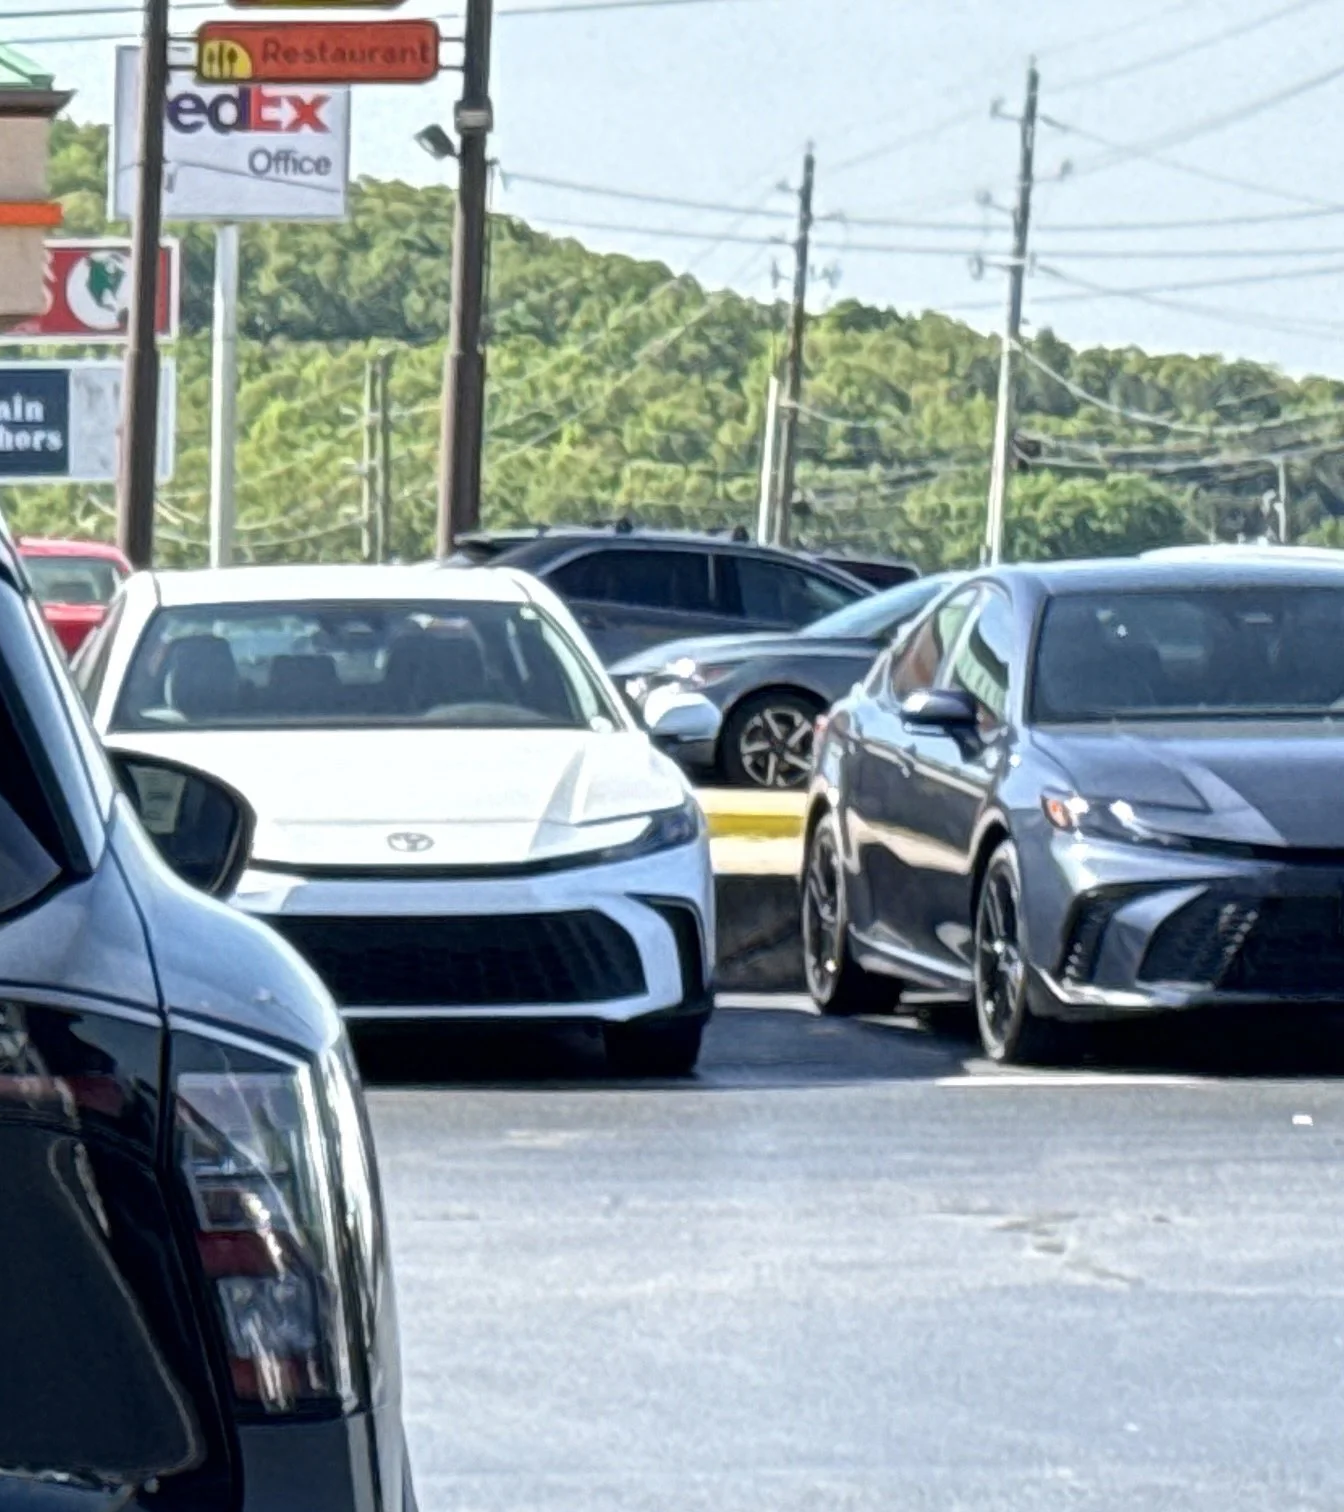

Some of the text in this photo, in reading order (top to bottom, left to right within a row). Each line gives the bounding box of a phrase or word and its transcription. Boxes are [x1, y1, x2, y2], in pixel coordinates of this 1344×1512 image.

[260, 38, 431, 66] Restaurant
[166, 86, 332, 134] edEx
[248, 147, 332, 177] Office
